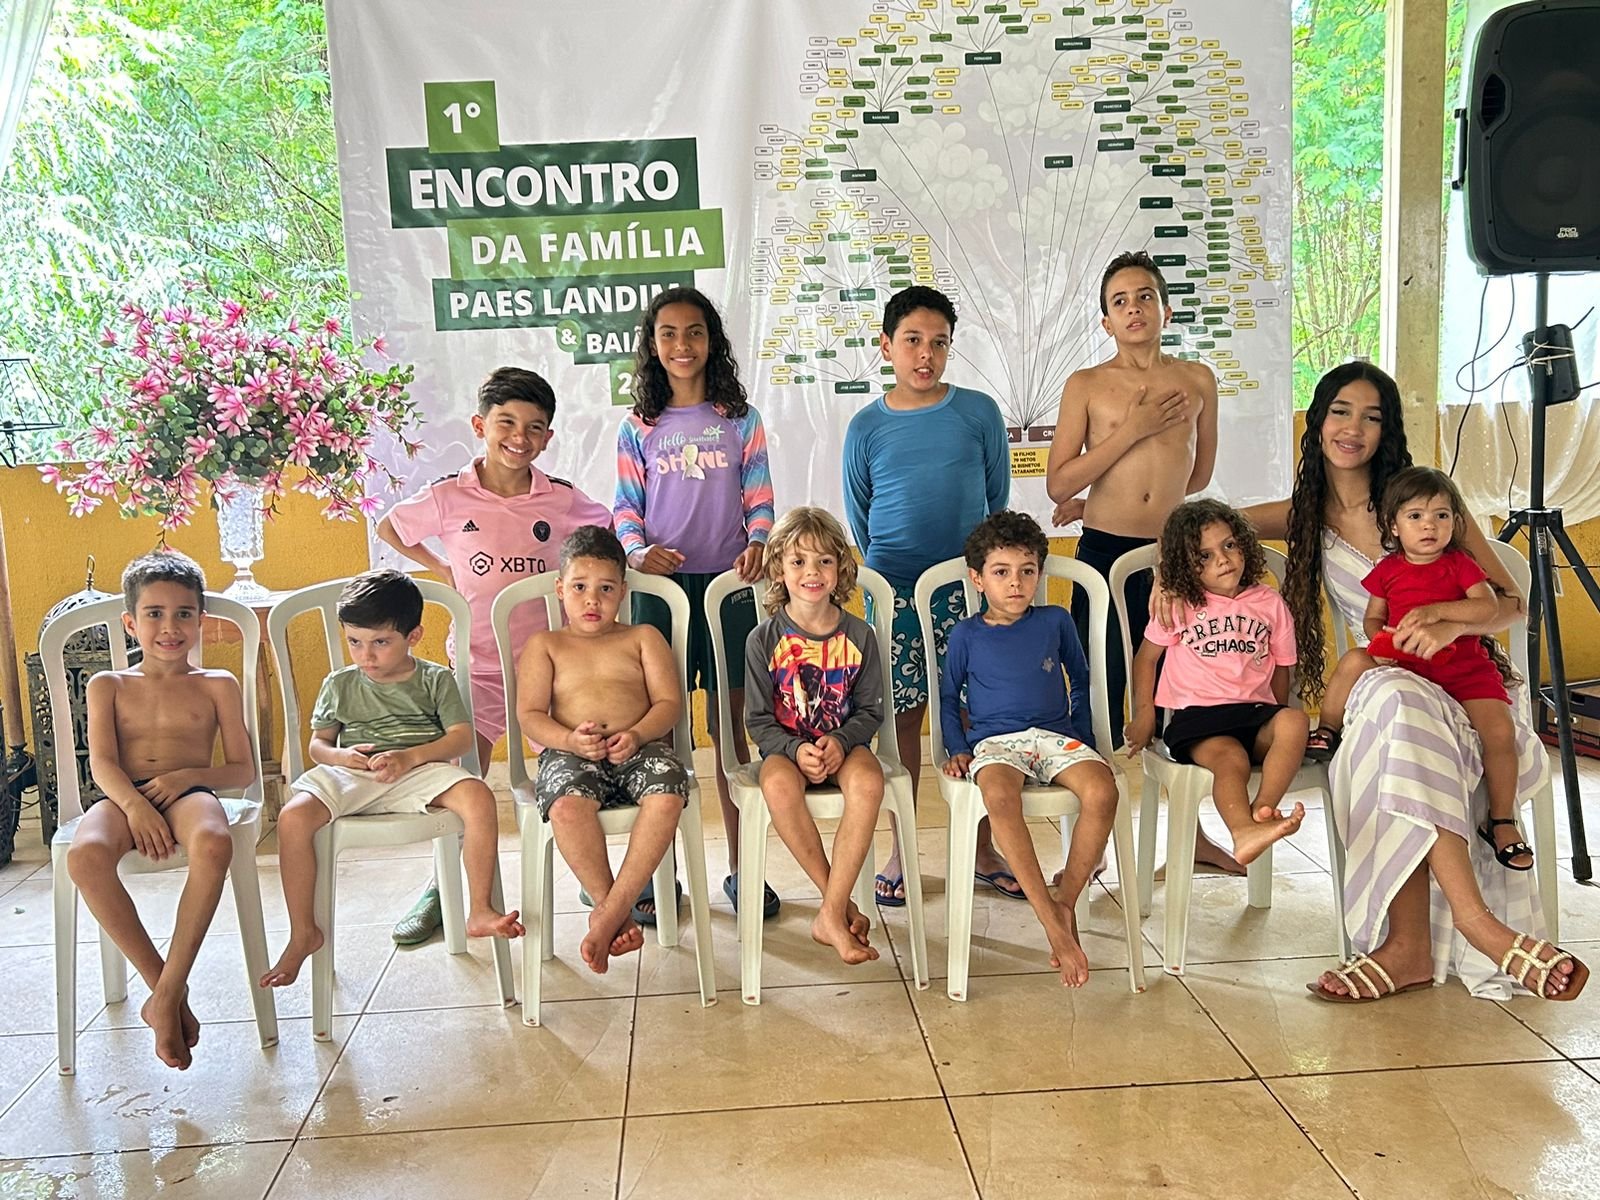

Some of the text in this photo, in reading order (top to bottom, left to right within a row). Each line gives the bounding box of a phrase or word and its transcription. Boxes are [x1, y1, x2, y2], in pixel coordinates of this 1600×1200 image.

[409, 161, 679, 210] ENCONTRO
[471, 221, 705, 266] DA FAMÍLIA
[450, 290, 533, 320] PAES
[561, 328, 578, 347] &
[658, 431, 687, 450] Hello
[500, 557, 546, 573] XBTO
[1204, 639, 1256, 654] CHAOS
